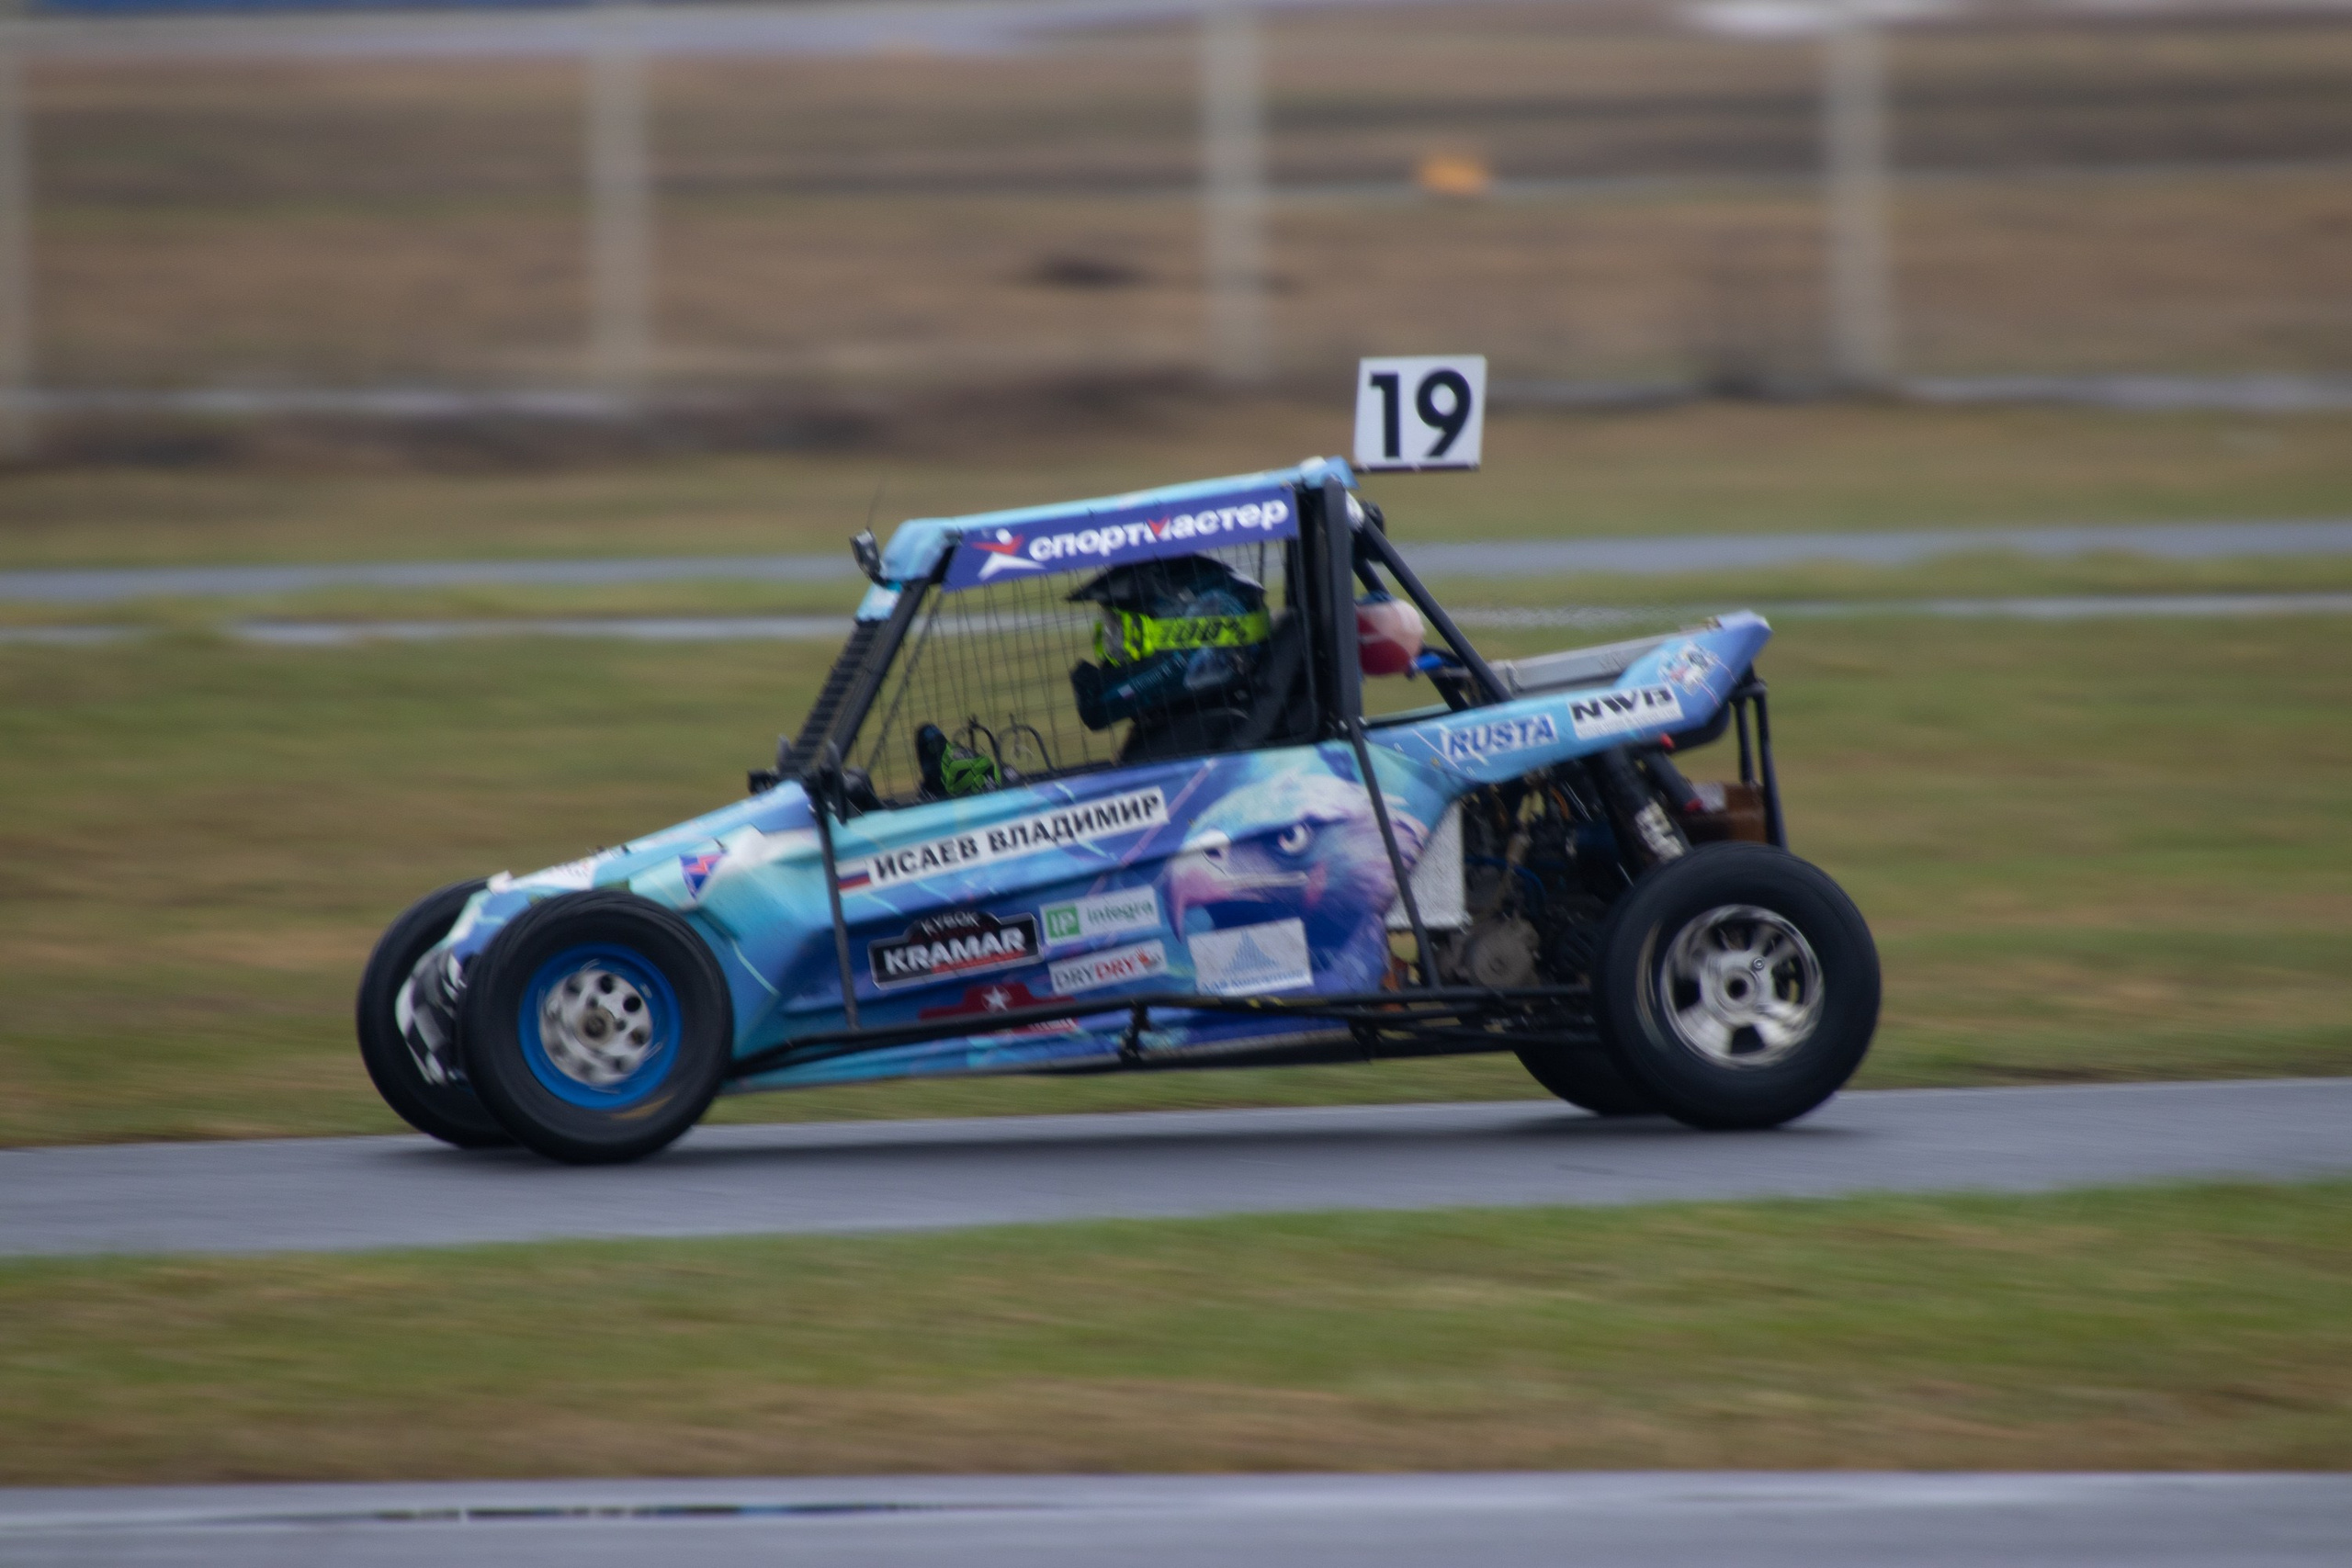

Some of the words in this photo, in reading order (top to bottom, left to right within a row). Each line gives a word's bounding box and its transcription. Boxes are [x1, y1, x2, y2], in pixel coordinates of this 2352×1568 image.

[1369, 368, 1473, 457] 19
[1447, 714, 1557, 760] RUSTA
[873, 835, 979, 880] ИСАЕВ
[988, 792, 1161, 854] ВЛАДИМИР
[922, 911, 980, 934] КУБОК
[883, 927, 1026, 975] KRAMAR
